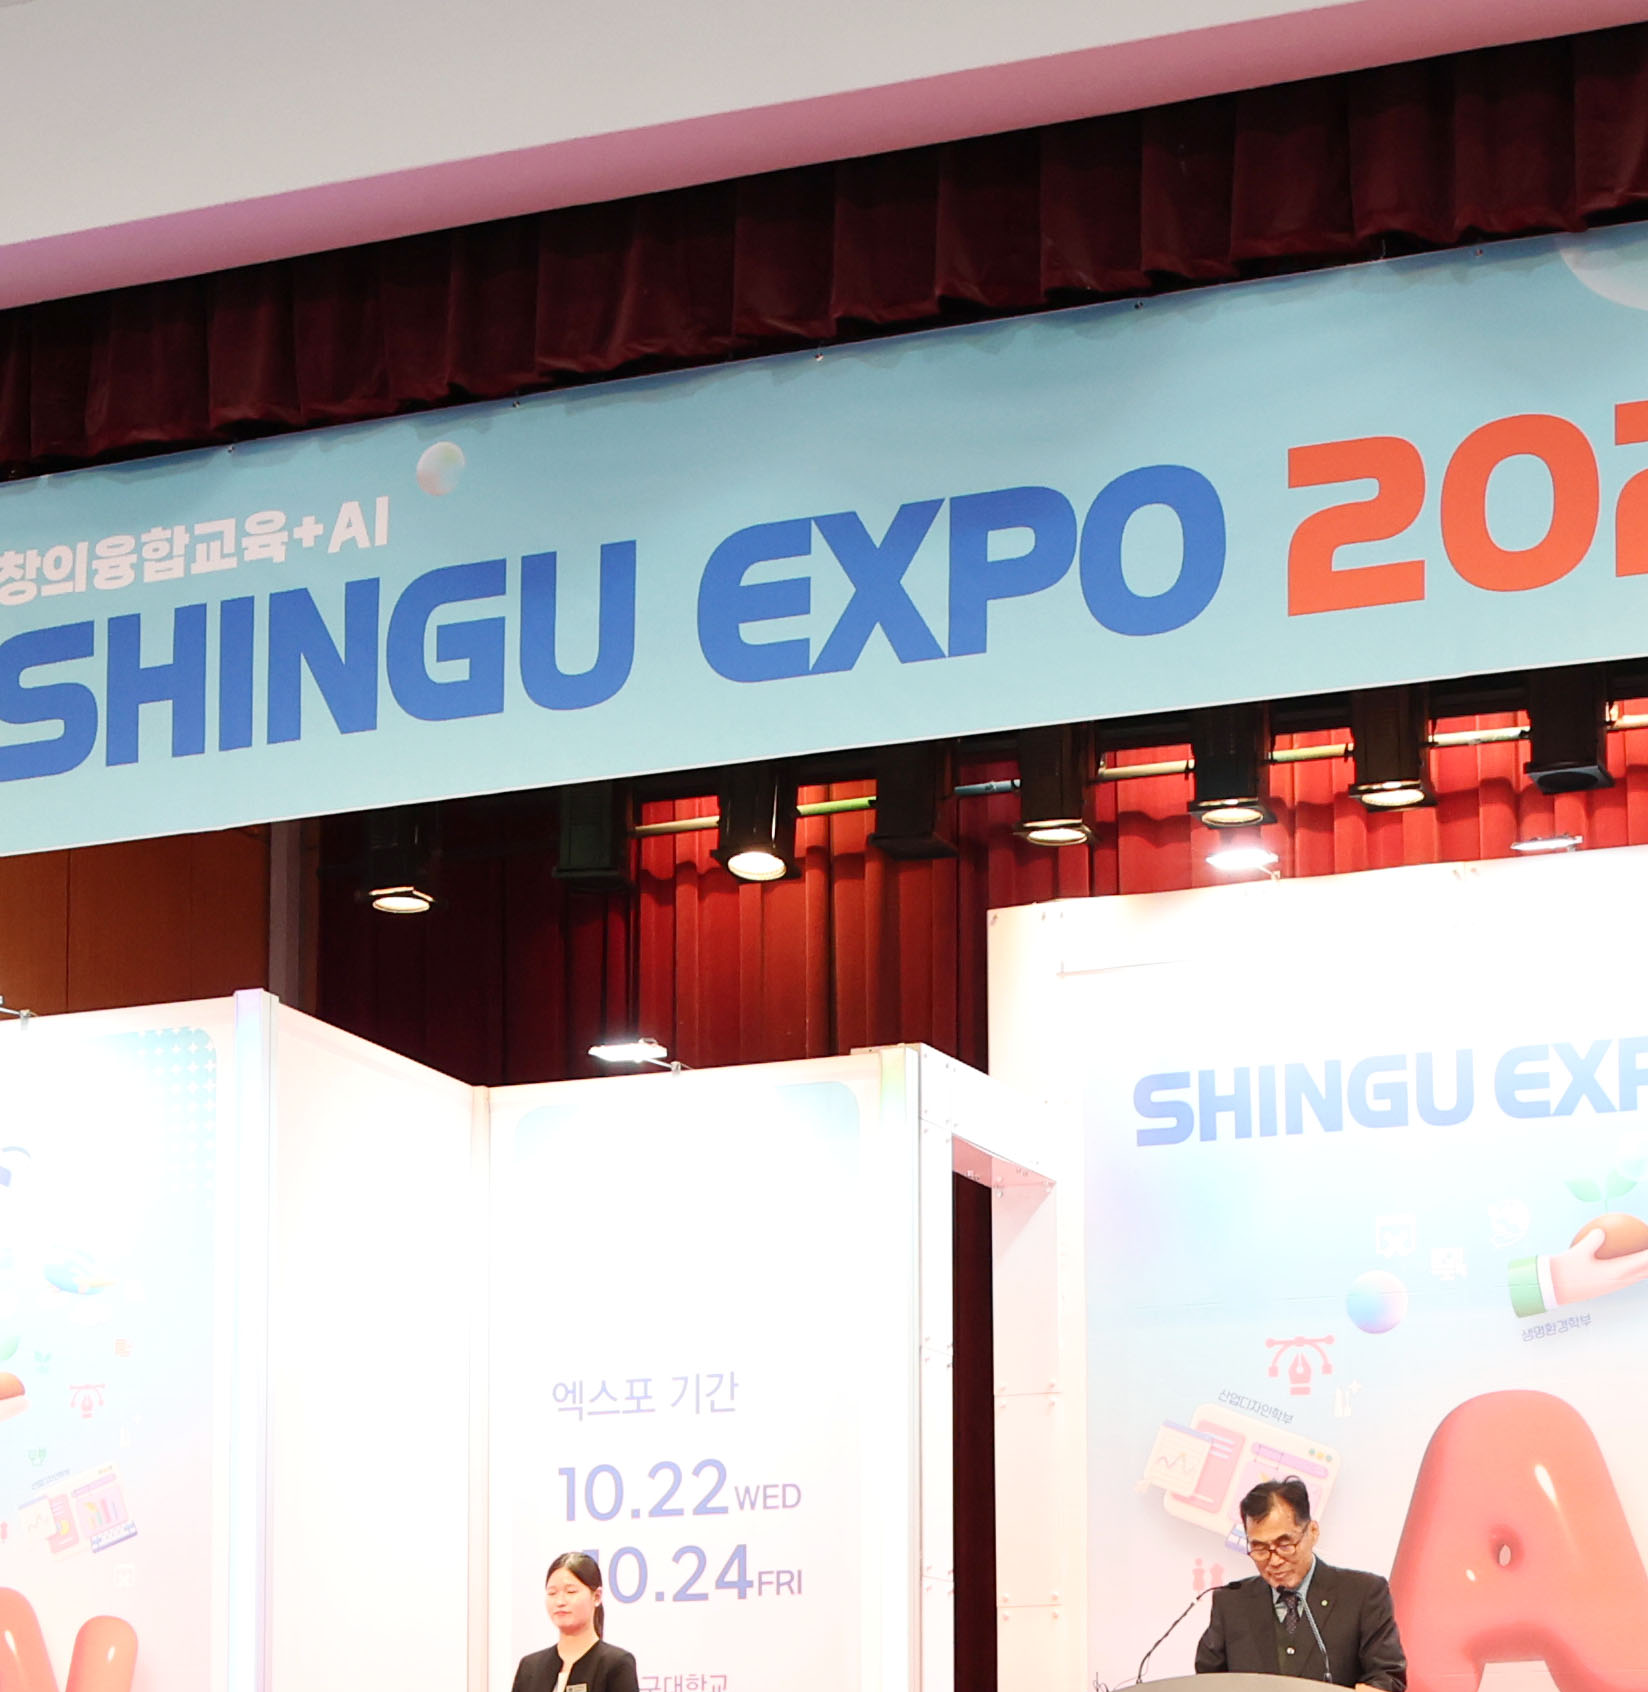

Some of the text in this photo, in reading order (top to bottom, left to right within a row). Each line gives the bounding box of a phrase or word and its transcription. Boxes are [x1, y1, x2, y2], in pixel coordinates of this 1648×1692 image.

[696, 462, 1228, 682] EXPO
[1132, 1047, 1475, 1148] SHINGU
[551, 1370, 741, 1423] 엑스포 기간
